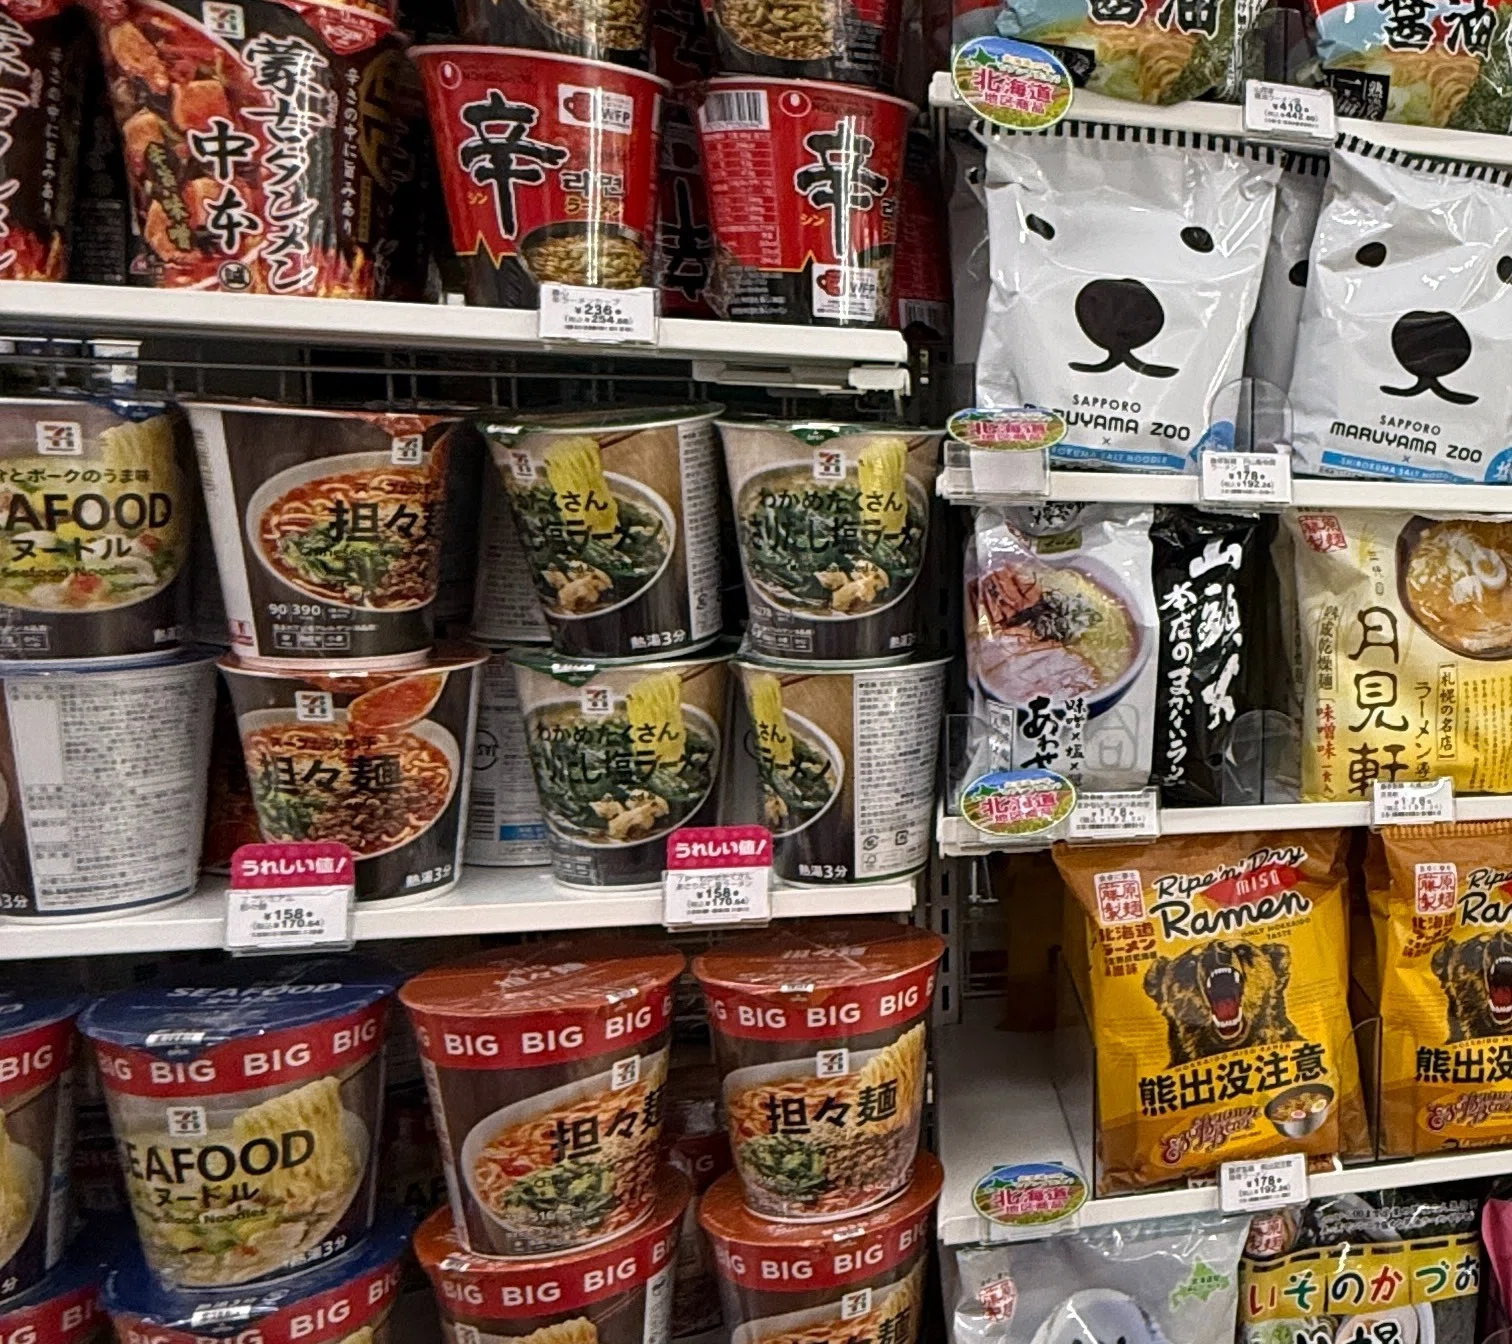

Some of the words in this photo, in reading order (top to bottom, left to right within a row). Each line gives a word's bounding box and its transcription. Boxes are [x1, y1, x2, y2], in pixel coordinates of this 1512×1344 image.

[972, 67, 1057, 103] 北海道
[239, 32, 328, 293] 蒙古タンメン
[459, 88, 570, 240] 辛
[187, 116, 262, 254] 中本
[1071, 393, 1142, 414] SAPPORO
[1379, 414, 1442, 436] SAPPORO
[1150, 421, 1191, 441] ZOO
[1329, 420, 1438, 457] MARUYAMA
[1445, 443, 1483, 464] ZOO
[757, 486, 905, 514] わかめたくさん
[11, 535, 133, 562] ヌードル
[1347, 604, 1411, 797] 月見軒
[256, 754, 402, 794] 担々麺
[1235, 869, 1281, 897] MISO
[1099, 921, 1155, 943] 北海道
[1149, 890, 1312, 940] Ramen
[737, 1003, 787, 1030] BIG
[805, 1000, 862, 1029] BIG
[878, 984, 934, 1019] BIG
[150, 1058, 216, 1086] BIG
[243, 1042, 312, 1078] BIG
[332, 1015, 379, 1055] BIG
[443, 1031, 500, 1058] BIG
[520, 1024, 585, 1055] BIG
[603, 1003, 653, 1041] BIG
[1138, 1040, 1328, 1118] 熊出没注意
[766, 1076, 899, 1138] 担々麺
[154, 1184, 261, 1209] ヌードル
[1249, 1254, 1482, 1318] いそのかづお
[289, 1299, 351, 1341] BIG
